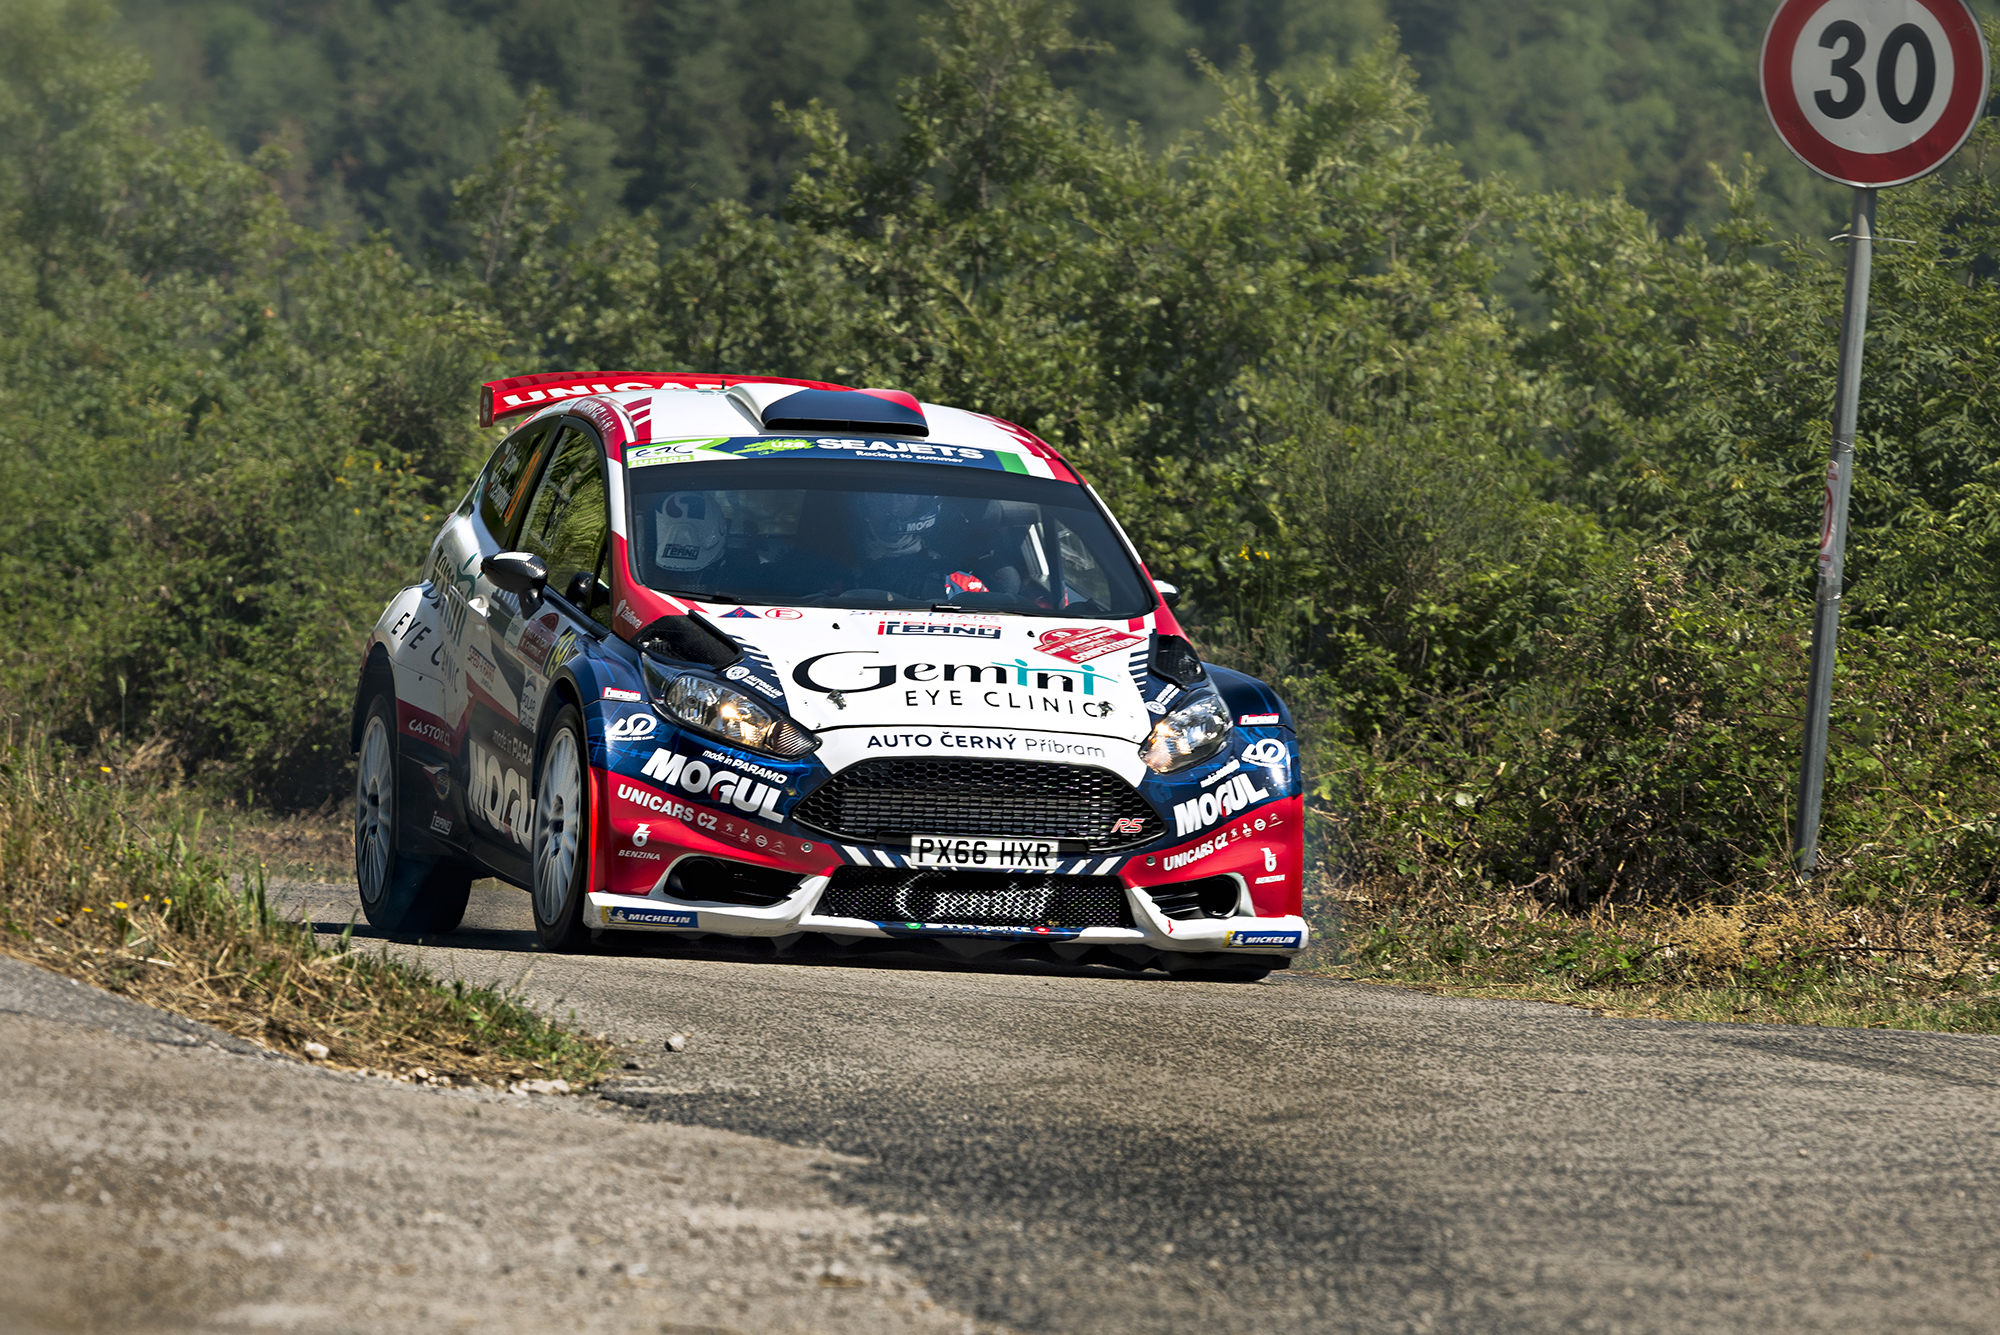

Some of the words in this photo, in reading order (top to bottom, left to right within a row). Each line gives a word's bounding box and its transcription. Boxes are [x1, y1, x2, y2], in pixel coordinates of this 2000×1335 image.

[1814, 20, 1936, 124] 30
[632, 454, 692, 466] JUNIOR
[816, 438, 984, 460] SEAJETS
[855, 450, 898, 459] Racing
[916, 455, 964, 463] summer
[391, 611, 432, 651] EYE
[792, 651, 1119, 696] Gemini
[906, 690, 965, 708] EYE
[984, 691, 1099, 719] CLINIC
[867, 734, 932, 749] AUTO
[940, 731, 1019, 750] ČERNÝ
[1025, 739, 1105, 759] Příbram
[702, 749, 725, 763] made
[724, 755, 733, 765] in
[732, 758, 788, 785] PARAMO
[641, 747, 786, 824] MOGUL
[617, 784, 694, 823] UNICARS
[696, 812, 719, 832] CZ
[1173, 773, 1269, 838] MOGUL
[1110, 818, 1145, 833] RS
[618, 850, 661, 861] BENZINA
[919, 838, 988, 865] PX66
[1000, 840, 1051, 867] HXR
[1163, 840, 1215, 871] UNICARS
[1214, 832, 1229, 851] CZ
[628, 912, 691, 924] MICHELIN
[1244, 936, 1297, 944] MICHELIN
